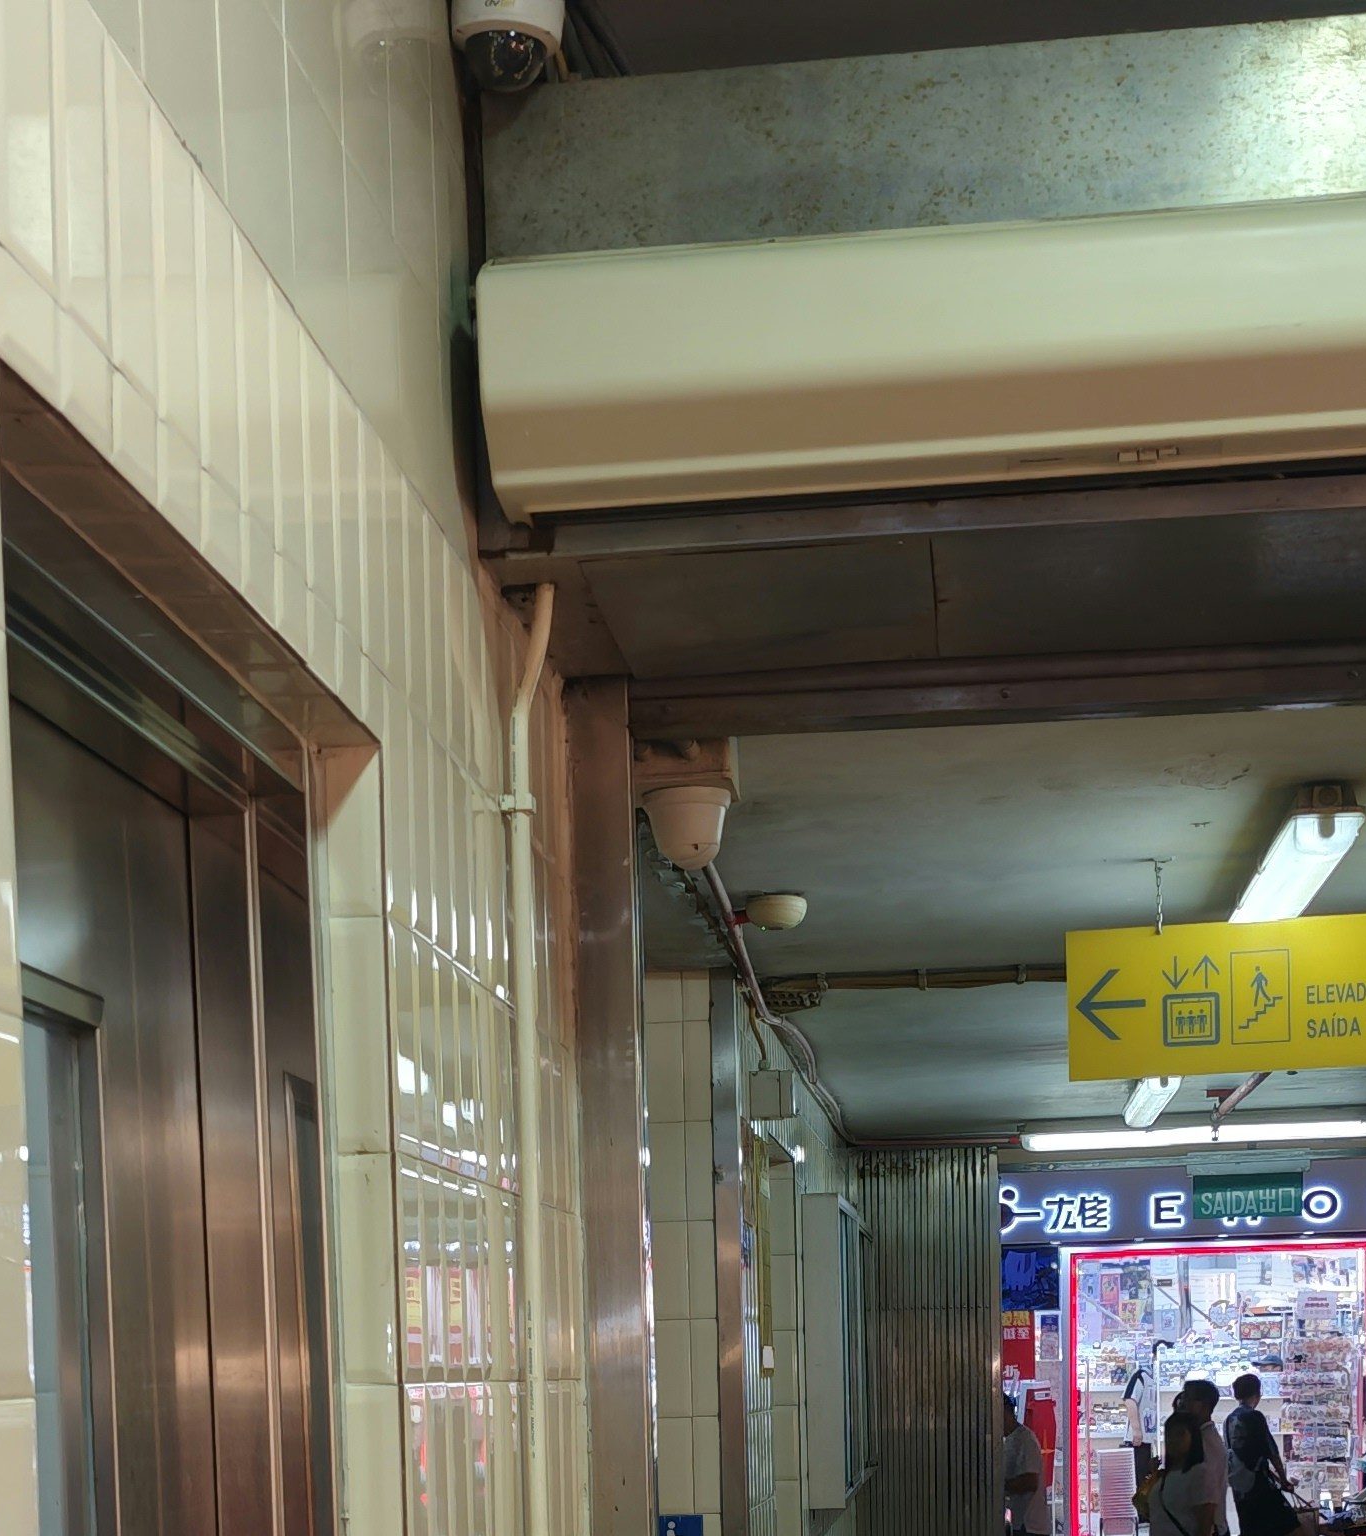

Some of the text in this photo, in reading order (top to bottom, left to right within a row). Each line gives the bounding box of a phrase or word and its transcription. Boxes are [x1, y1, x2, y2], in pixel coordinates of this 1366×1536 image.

[1306, 1012, 1362, 1038] SAÍDA
[1200, 1187, 1295, 1215] SAÍDA 出口
